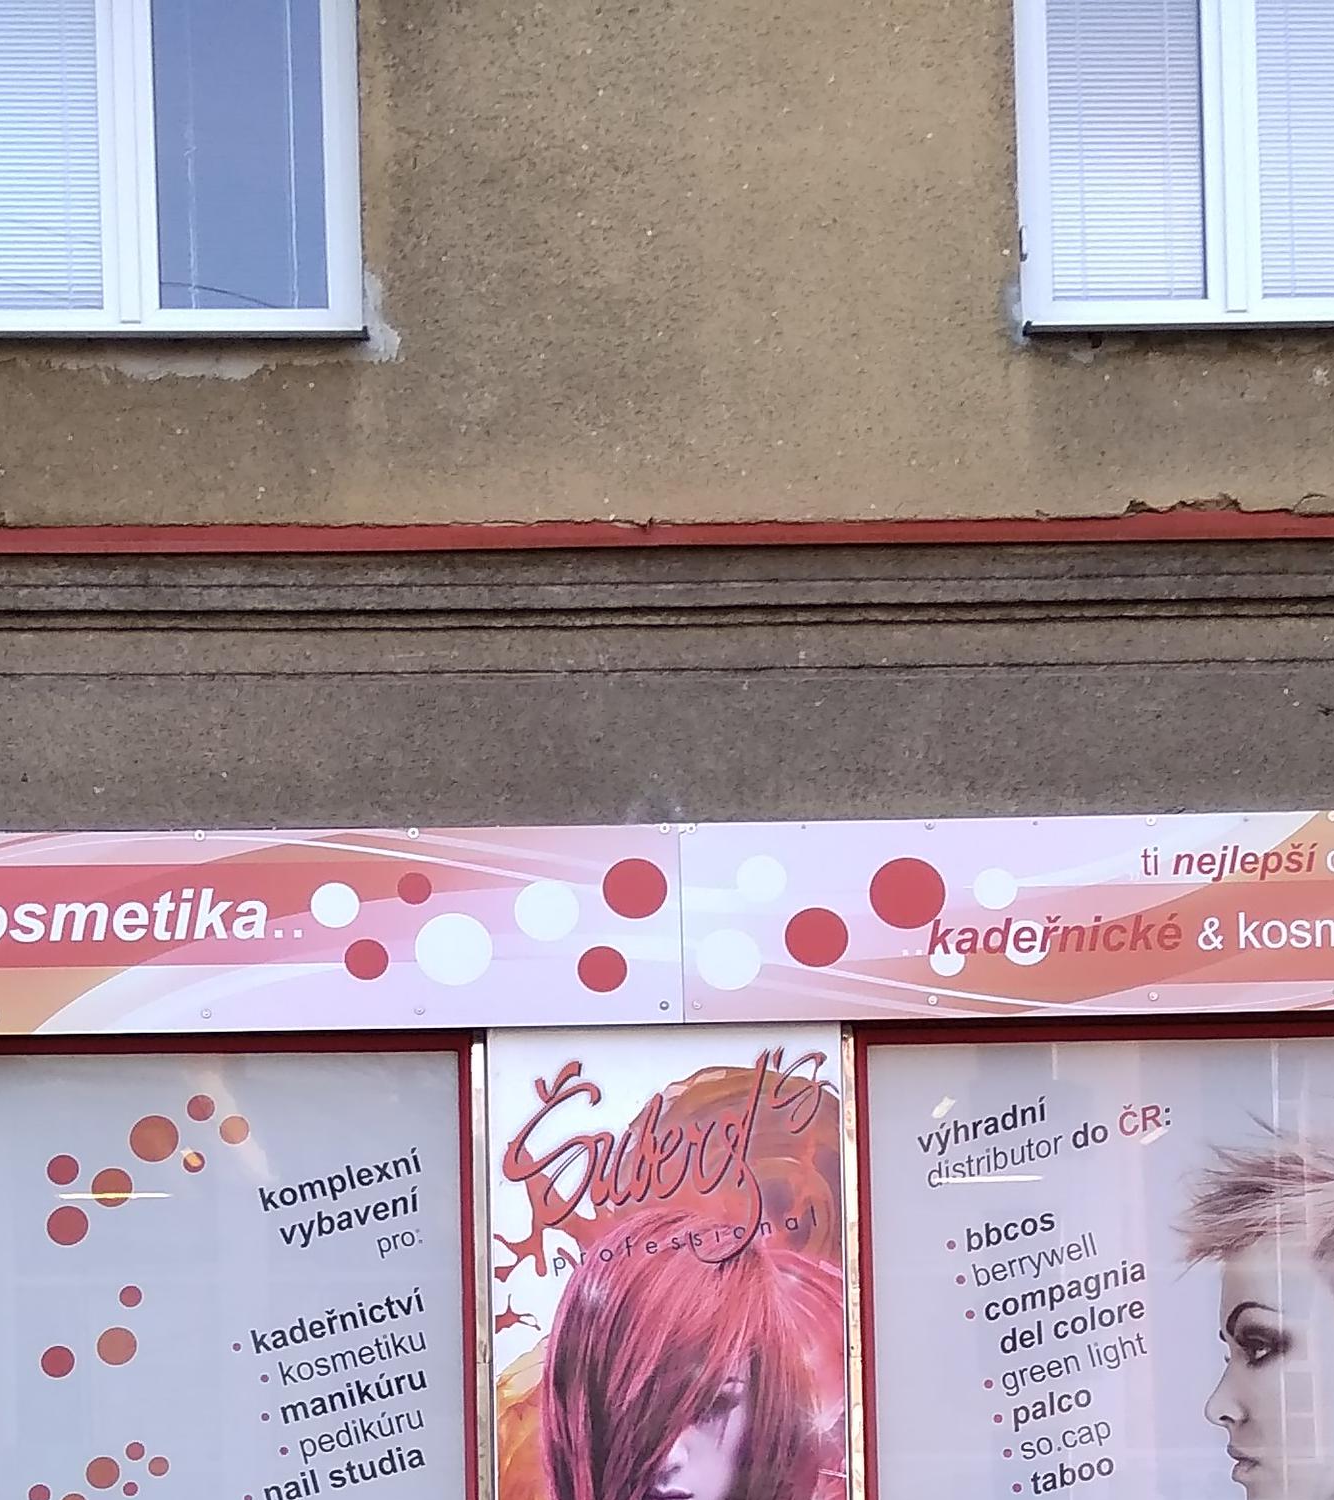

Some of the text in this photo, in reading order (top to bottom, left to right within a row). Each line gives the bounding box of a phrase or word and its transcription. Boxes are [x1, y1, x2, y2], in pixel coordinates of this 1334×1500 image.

[1172, 842, 1316, 882] nejlepší
[1197, 916, 1224, 952] &
[917, 1095, 1048, 1157] výhradní
[927, 1103, 1172, 1190] distributor do ČR:
[258, 1147, 423, 1213] komplexní
[279, 1186, 419, 1249] vybavení
[552, 1205, 818, 1278] professional
[965, 1211, 1056, 1253] bbcos
[972, 1232, 1099, 1287] berrywell
[983, 1258, 1147, 1323] compagnia
[250, 1286, 425, 1355] kadeřnictví
[999, 1299, 1146, 1355] del colore
[277, 1330, 427, 1387] kosmetiku
[1001, 1331, 1148, 1398] green light
[280, 1369, 428, 1425] manikúru
[1012, 1386, 1092, 1432] palco
[298, 1408, 425, 1464] pedikúru
[1020, 1418, 1112, 1460] so.cap
[328, 1445, 427, 1490] studia
[1030, 1455, 1116, 1496] taboo
